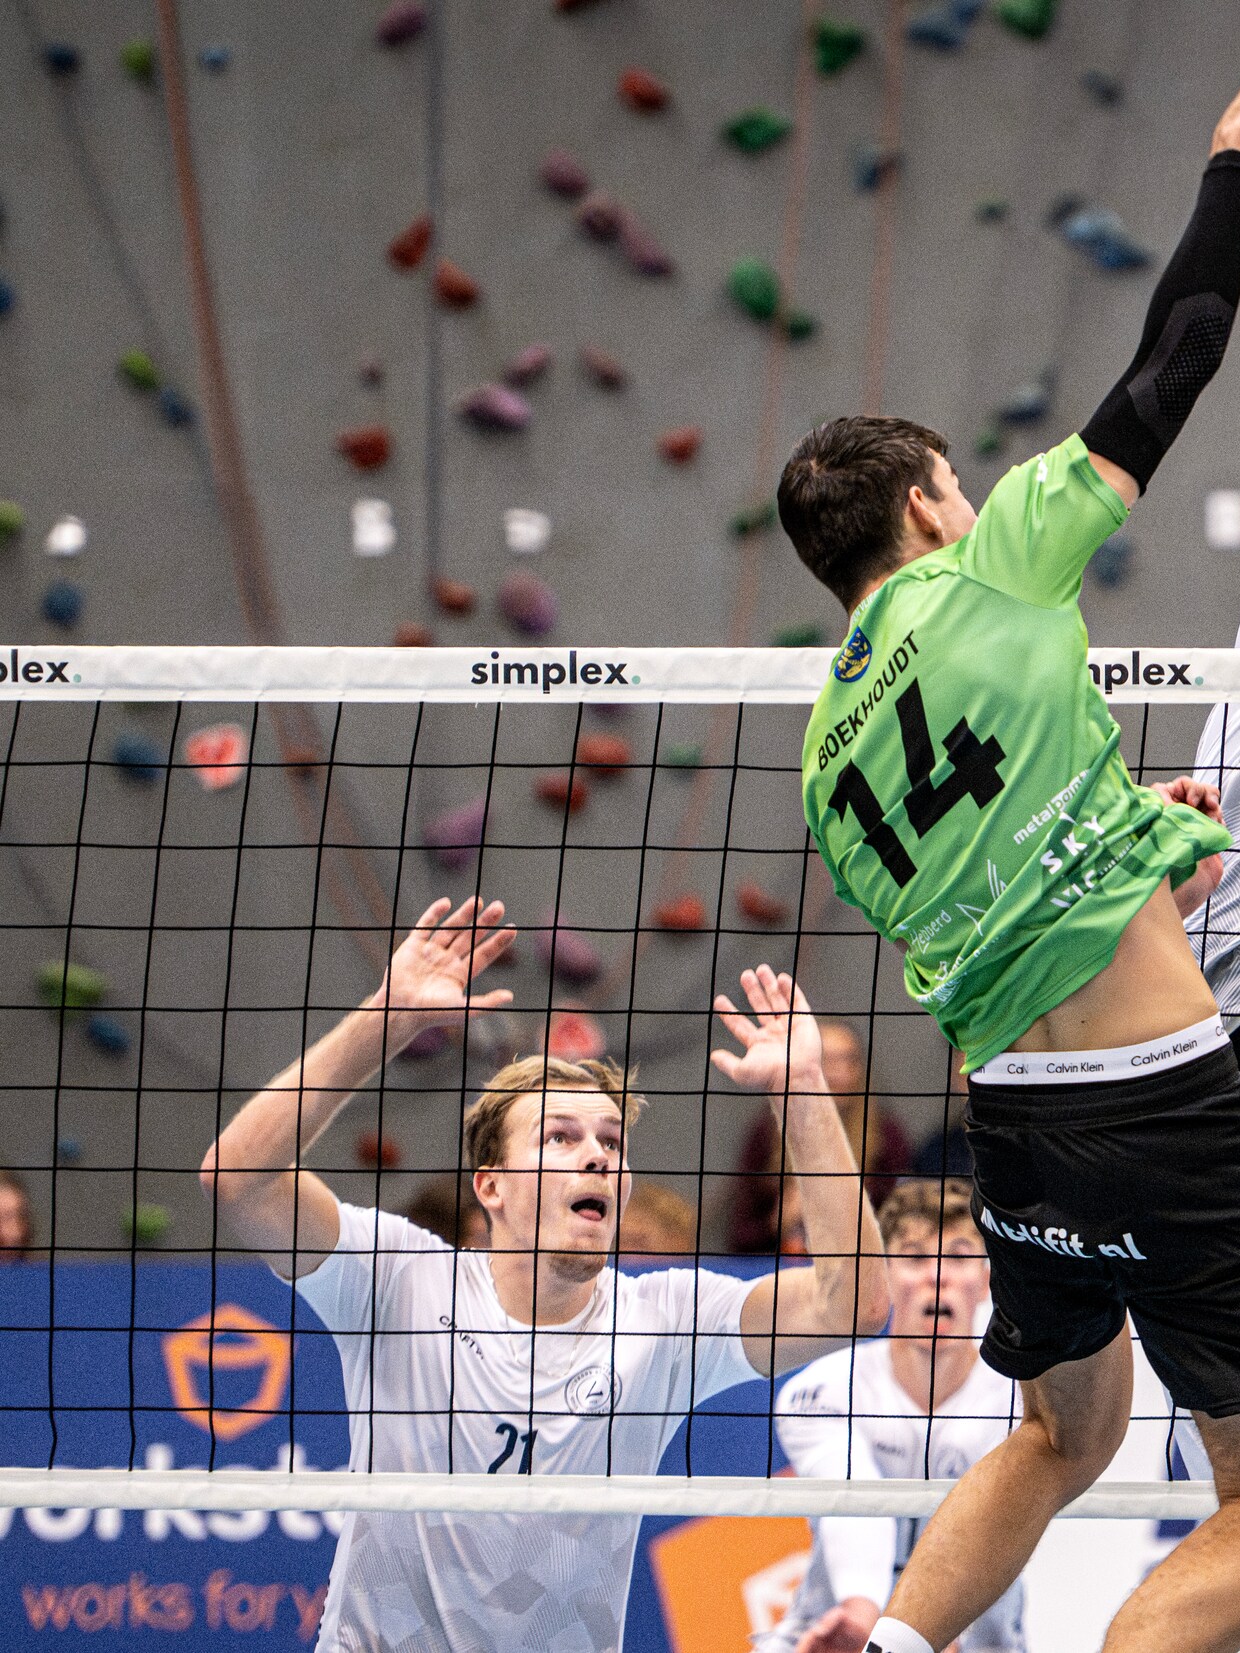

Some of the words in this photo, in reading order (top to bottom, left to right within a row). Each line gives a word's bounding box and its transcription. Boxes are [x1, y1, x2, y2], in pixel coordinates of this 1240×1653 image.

[470, 650, 641, 694] simplex.
[818, 629, 919, 771] BOEKHOUDT
[827, 676, 1007, 889] 14
[1040, 815, 1105, 875] SKY
[1046, 1062, 1079, 1074] Calvin
[1080, 1062, 1104, 1074] Klein
[1130, 1048, 1171, 1067] Calvin
[1173, 1039, 1198, 1057] Klein
[487, 1422, 539, 1474] 21
[20, 1570, 196, 1634] works
[202, 1567, 286, 1634] for
